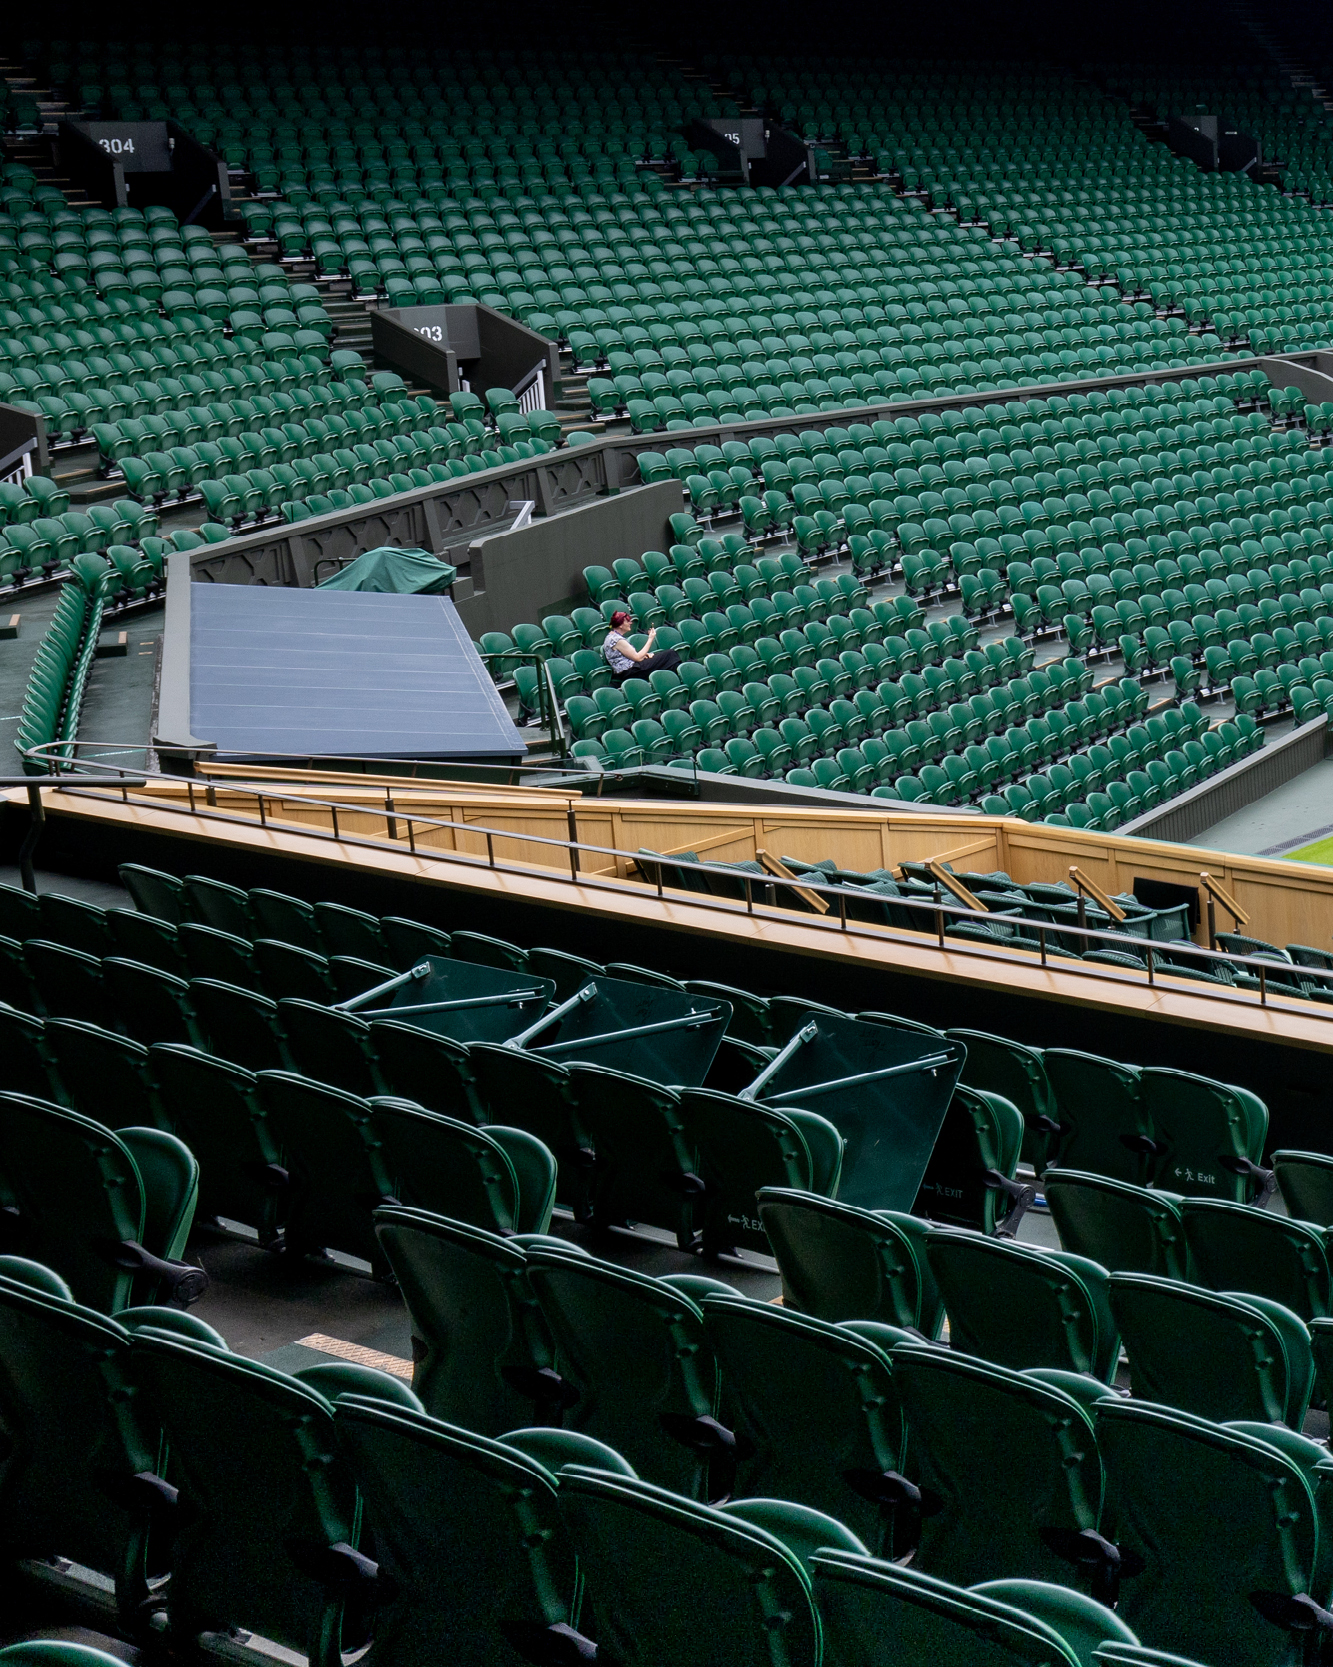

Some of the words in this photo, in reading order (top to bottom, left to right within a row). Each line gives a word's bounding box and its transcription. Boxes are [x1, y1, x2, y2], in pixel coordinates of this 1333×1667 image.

[98, 138, 135, 154] 304
[1197, 1172, 1216, 1185] Exit
[944, 1186, 963, 1199] EXIT
[751, 1219, 766, 1232] EX
